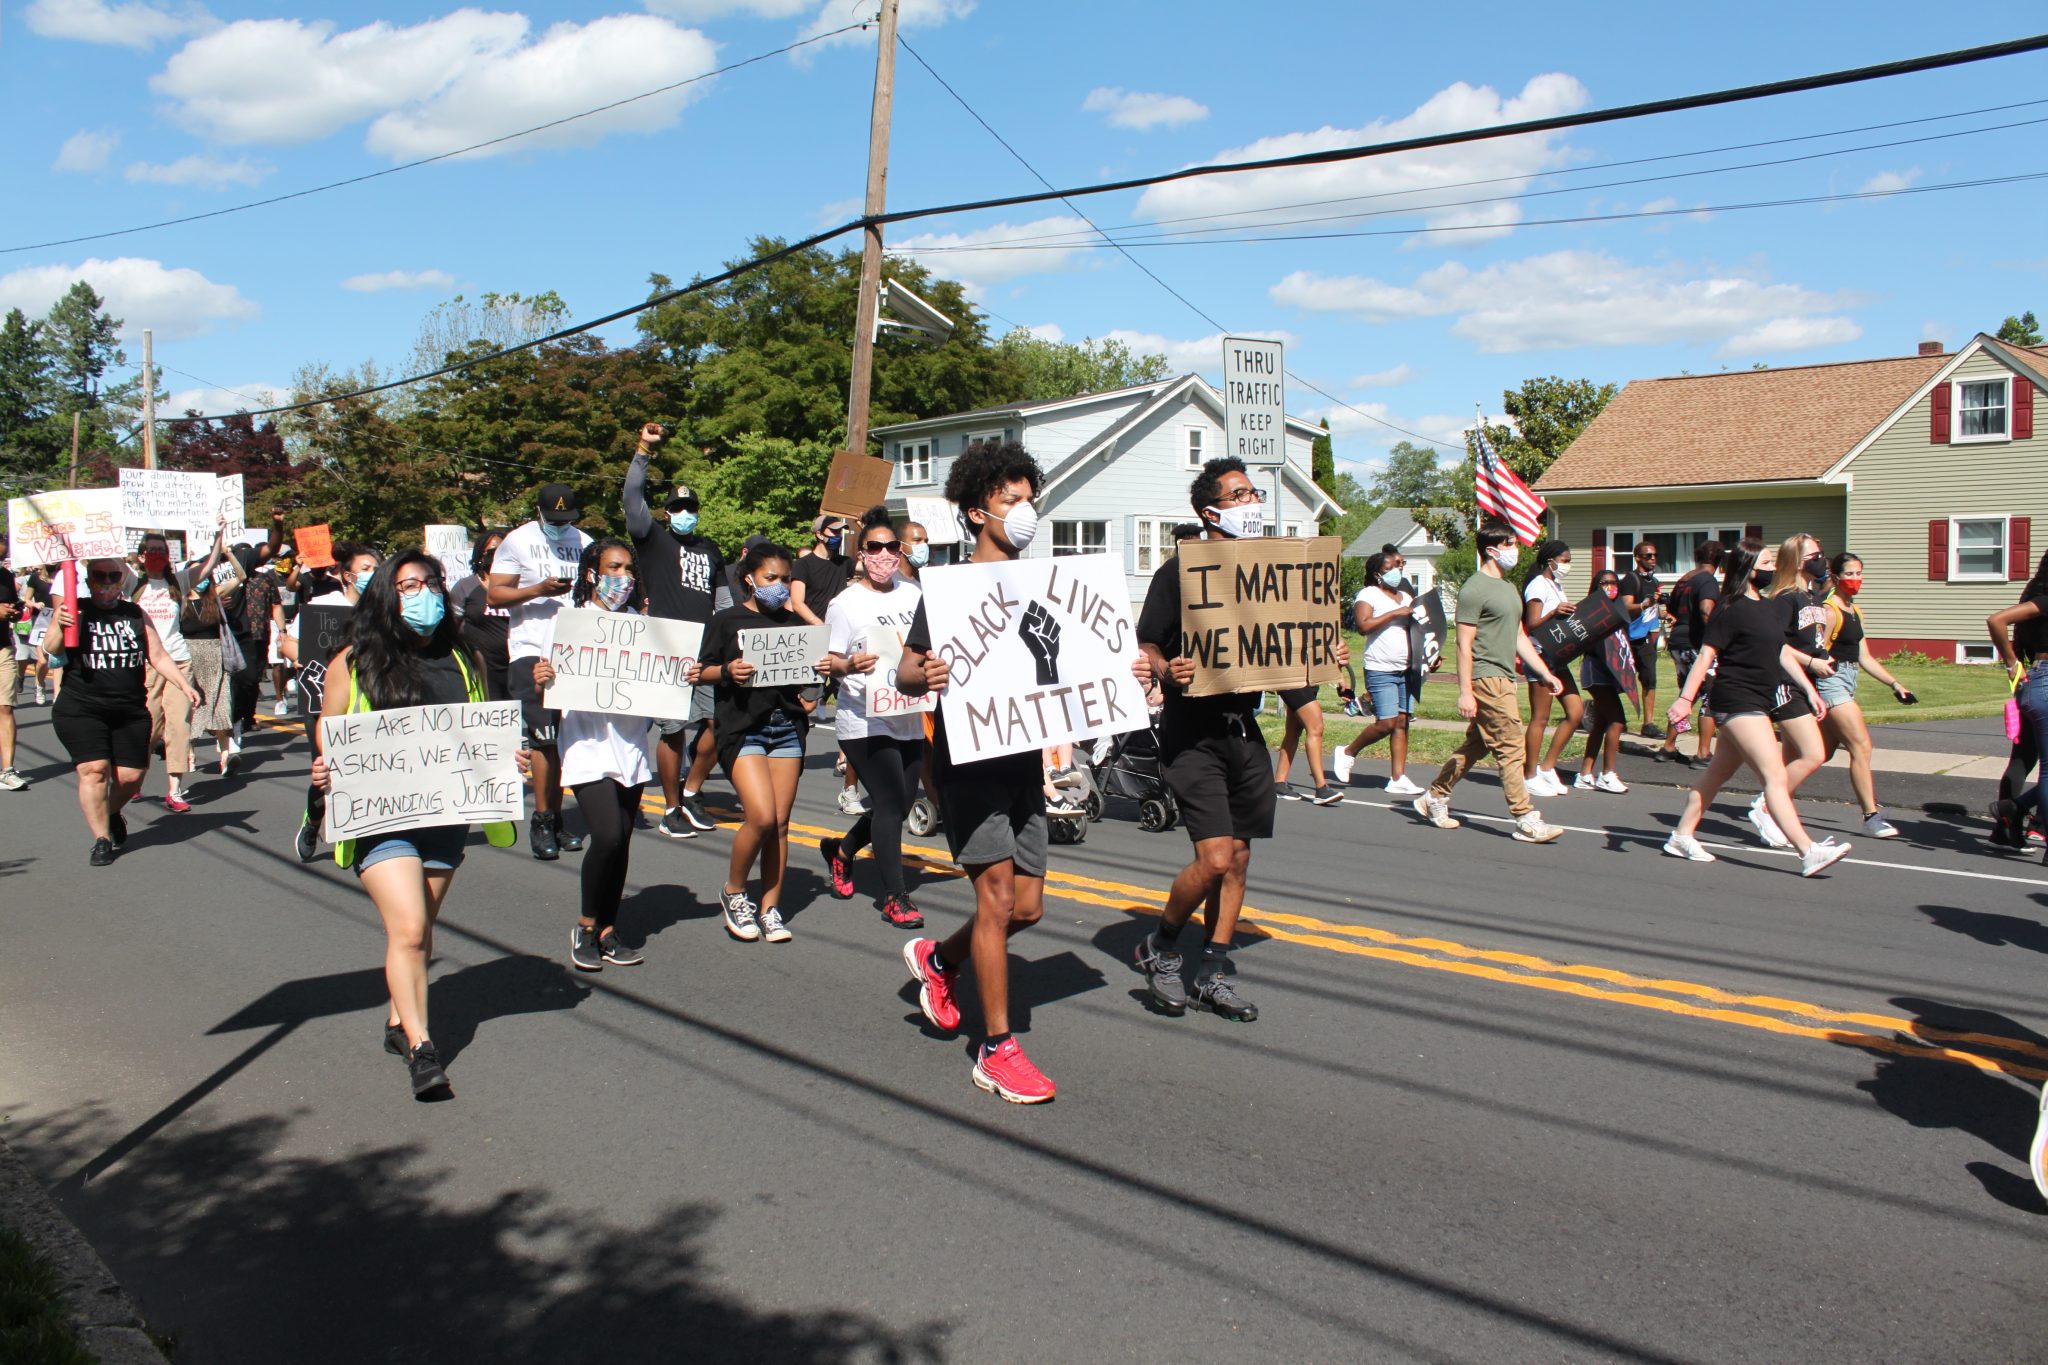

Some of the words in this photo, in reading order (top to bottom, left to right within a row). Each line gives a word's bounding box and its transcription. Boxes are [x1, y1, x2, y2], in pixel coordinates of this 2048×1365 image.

[1234, 350, 1274, 375] THRU
[1229, 381, 1281, 406] TRAFFIC
[1240, 413, 1272, 431] KEEP
[1239, 437, 1275, 455] RIGHT
[121, 480, 145, 490] grow
[151, 481, 159, 489] is
[165, 480, 202, 491] directly
[151, 473, 177, 482] ability
[156, 499, 165, 507] to
[168, 499, 208, 508] entertain
[196, 491, 206, 499] an
[555, 496, 568, 511] A
[1242, 520, 1263, 534] PODC
[530, 544, 550, 560] MY
[539, 563, 552, 578] IS
[680, 558, 711, 579] OVER
[1187, 564, 1224, 610] I
[1235, 554, 1340, 606] MATTER!
[88, 620, 136, 636] BLACK
[312, 611, 339, 631] The
[938, 581, 1020, 688] BLACK
[1046, 564, 1129, 655] LIVES
[1566, 612, 1590, 642] WHEN
[594, 617, 646, 646] STOP
[1549, 623, 1567, 644] IS
[92, 635, 139, 652] LIVES
[751, 632, 809, 652] BLACK
[1183, 627, 1231, 670] WE
[1237, 620, 1340, 668] MATTER!
[82, 651, 144, 670] MATTER
[550, 643, 696, 688] KILLING
[762, 648, 805, 666] LIVES
[596, 680, 632, 711] US
[965, 677, 1128, 752] MATTER
[325, 719, 362, 748] WE
[375, 714, 416, 740] ARE
[421, 706, 453, 733] NO
[461, 706, 521, 730] LONGER
[329, 749, 413, 778] ASKING,
[418, 745, 451, 768] WE
[456, 741, 499, 762] ARE
[331, 790, 445, 829] DEMANDING
[450, 768, 518, 808] JUSTICE
